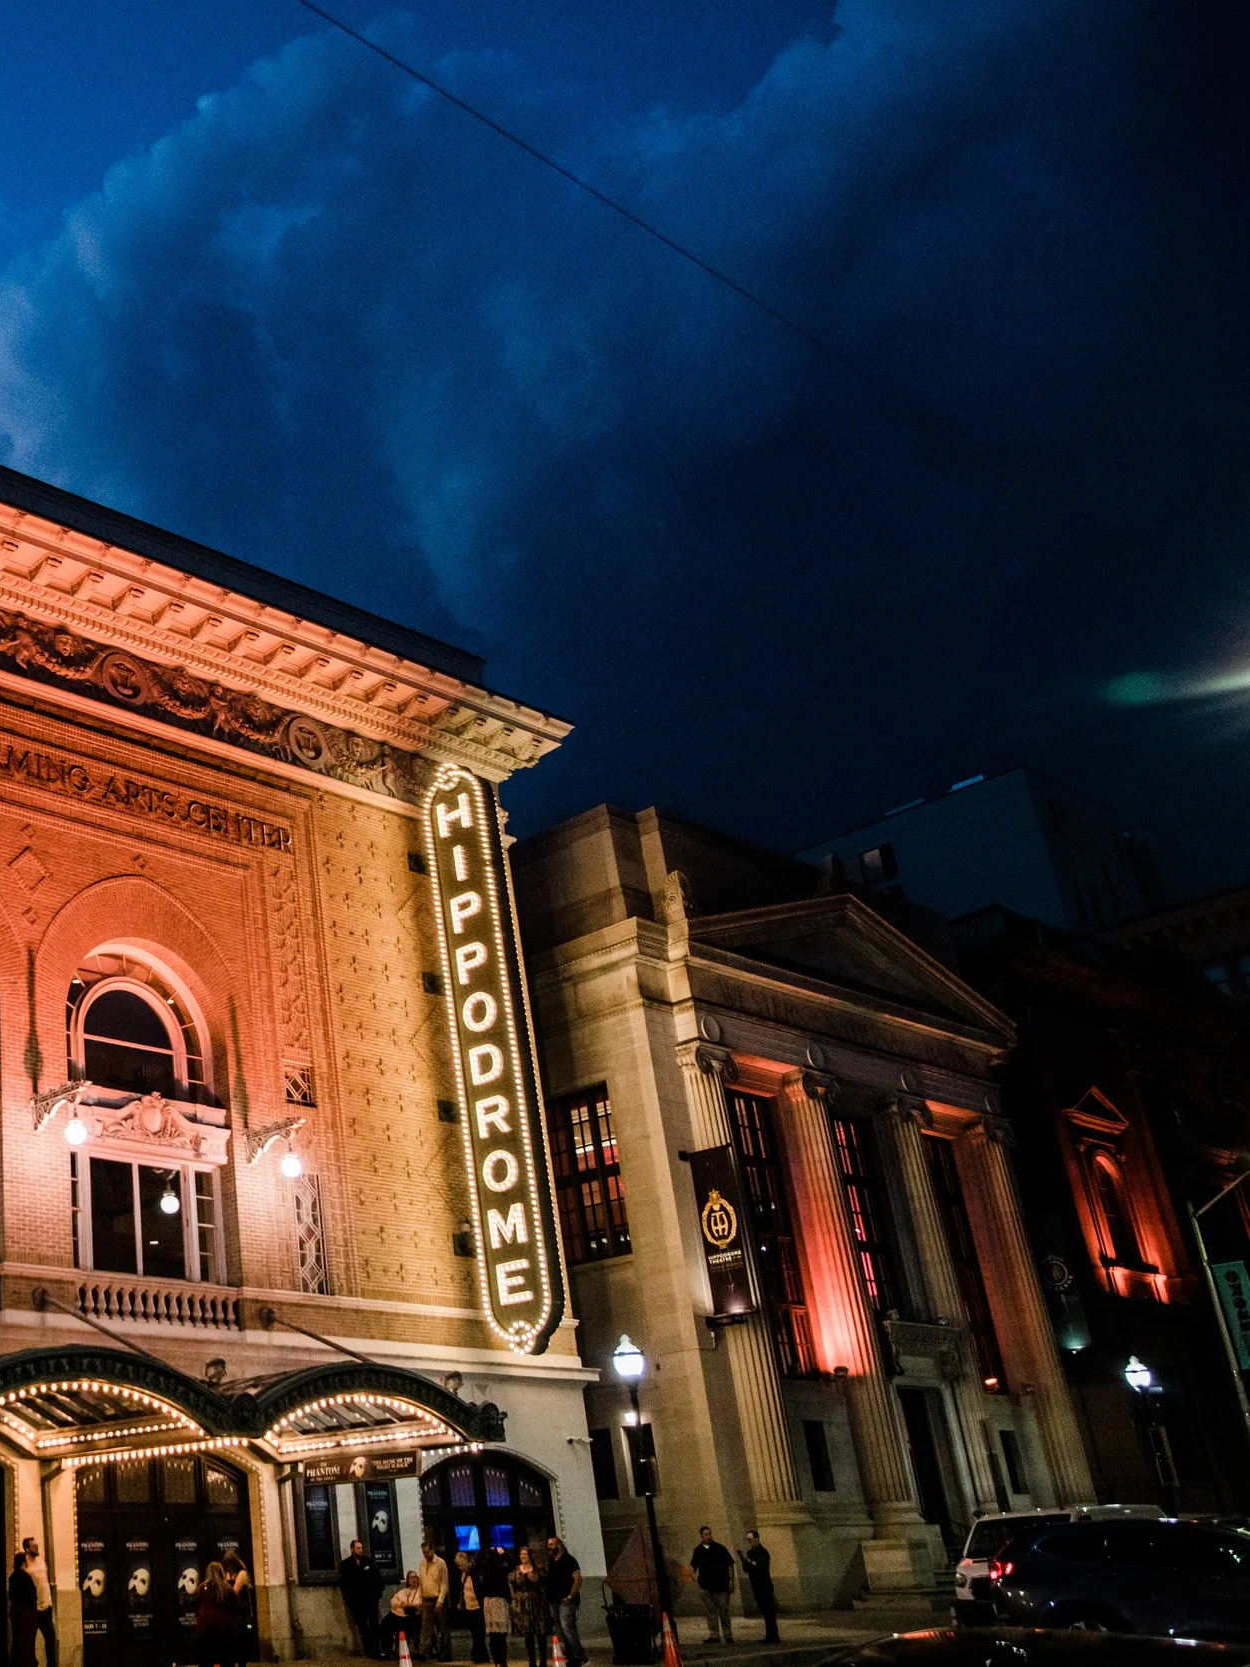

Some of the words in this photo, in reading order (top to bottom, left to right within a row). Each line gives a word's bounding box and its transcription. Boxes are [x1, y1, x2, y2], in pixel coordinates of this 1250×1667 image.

[104, 775, 180, 818] ARTS
[188, 797, 295, 854] CENTER
[435, 791, 534, 1306] HIPPODROME
[306, 1466, 340, 1478] PHANTOM
